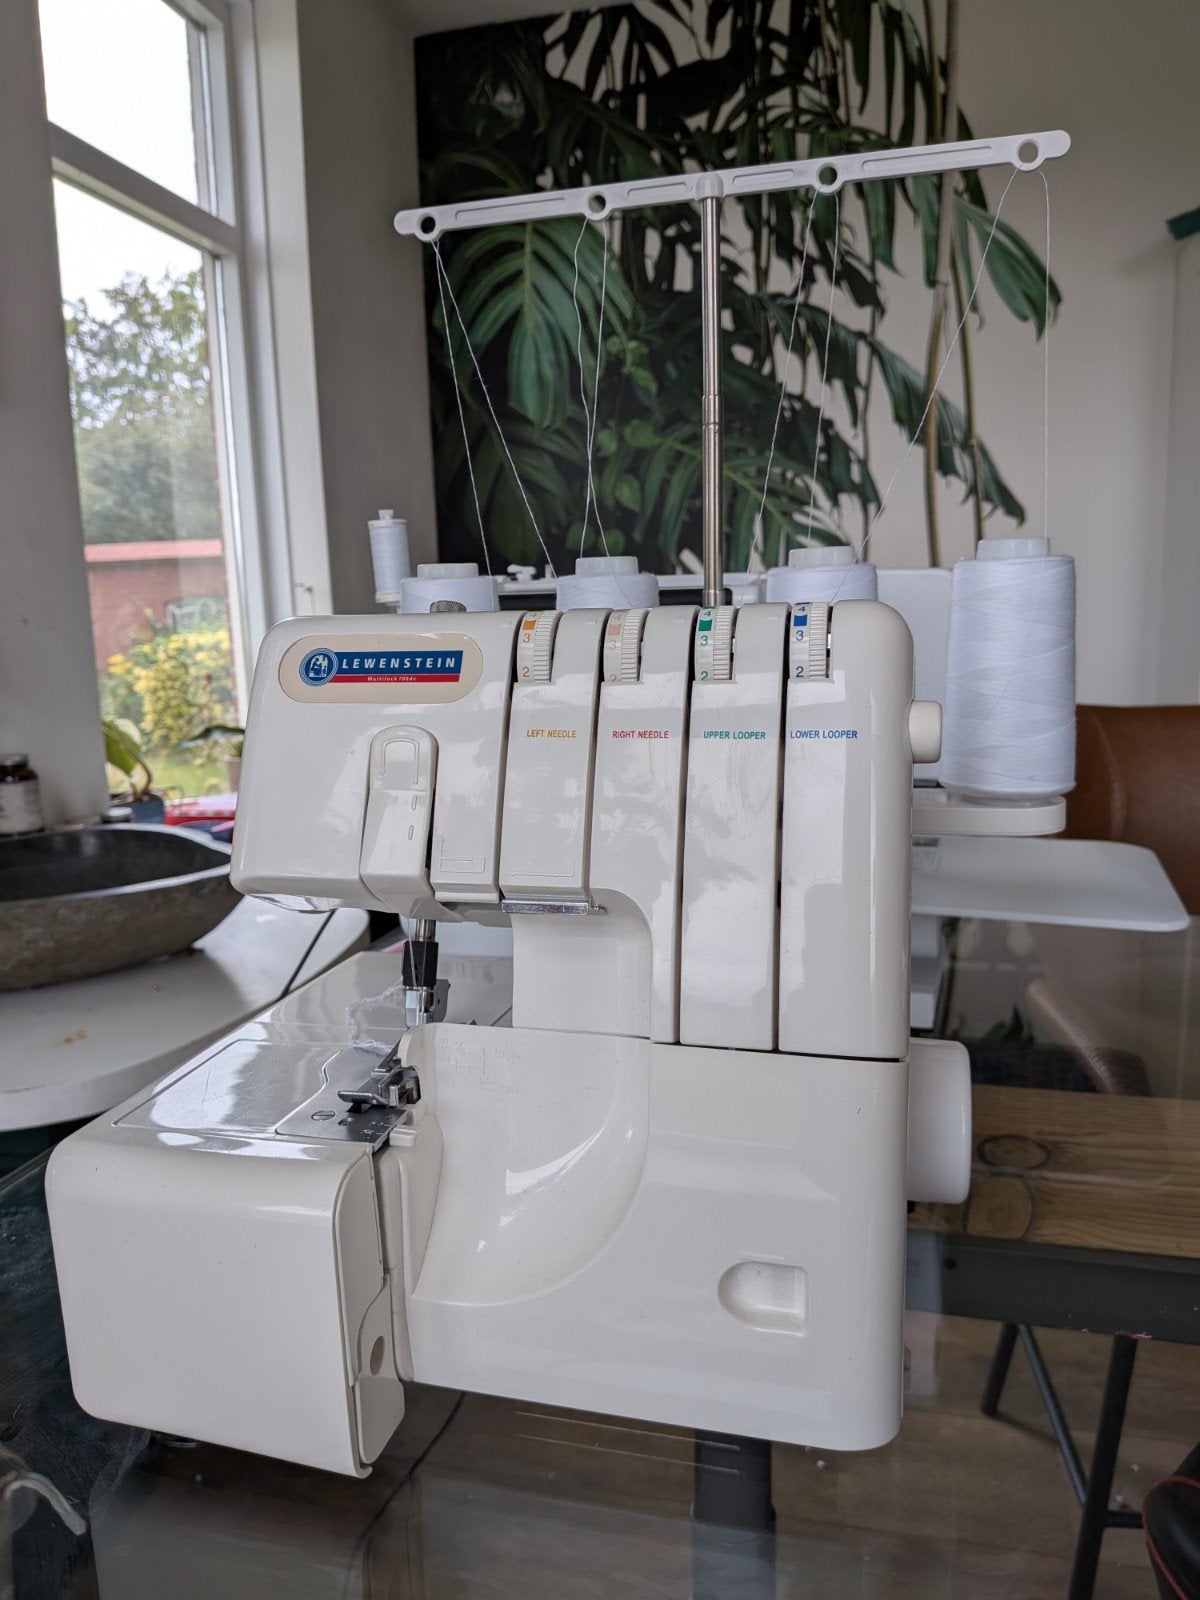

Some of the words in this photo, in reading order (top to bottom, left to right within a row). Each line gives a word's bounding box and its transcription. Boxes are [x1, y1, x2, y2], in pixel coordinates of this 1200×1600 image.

[523, 633, 531, 644] 3
[700, 635, 708, 647] 3
[795, 630, 804, 642] 3
[609, 639, 617, 651] 3
[342, 657, 456, 669] LEWENSTEIN
[522, 666, 530, 678] 2
[796, 665, 804, 678] 2
[526, 729, 544, 738] LEFT
[547, 729, 577, 739] NEEDLE
[612, 730, 635, 739] RIGHT
[637, 730, 669, 739] NEEDLE
[703, 730, 730, 740] UPPER
[732, 730, 766, 740] LOOPER
[790, 730, 820, 739] LOWER
[822, 730, 858, 739] LOOPER
